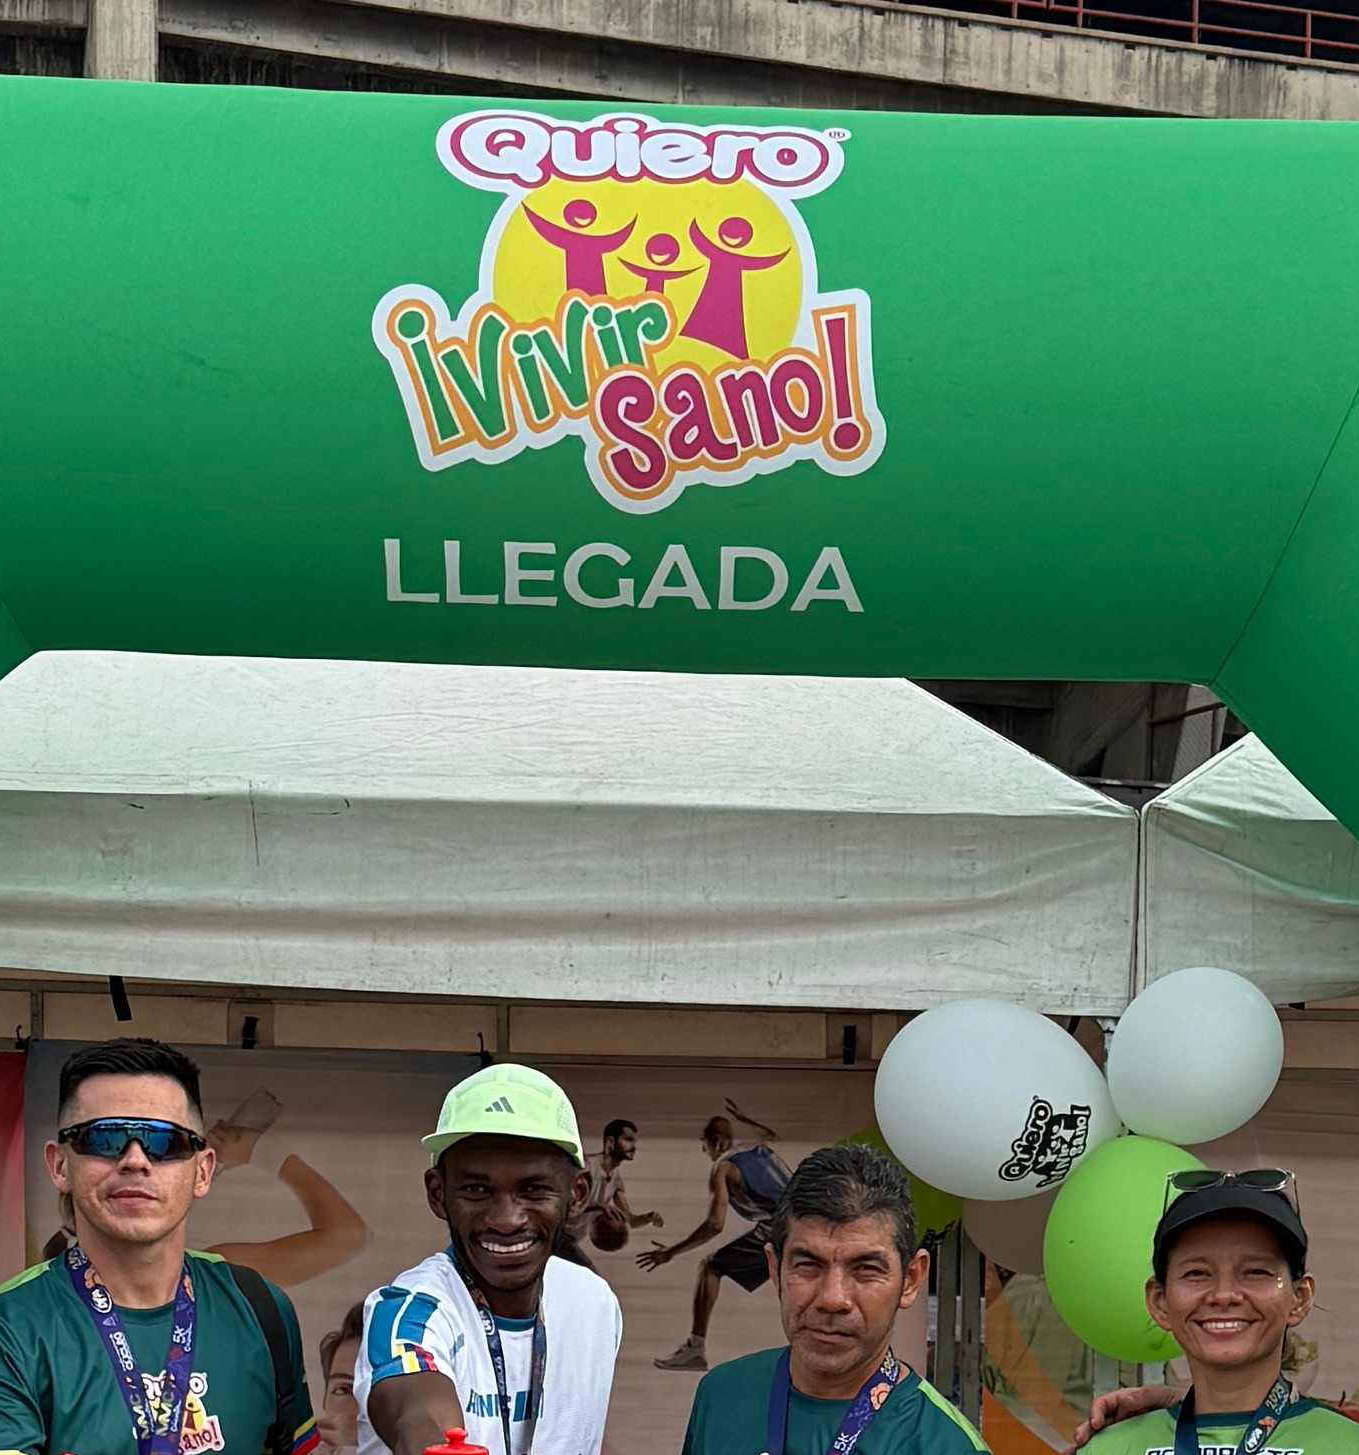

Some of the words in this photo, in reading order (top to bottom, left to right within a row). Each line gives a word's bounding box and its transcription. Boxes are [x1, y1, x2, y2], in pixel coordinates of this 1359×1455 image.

[451, 116, 829, 186] Quiero
[383, 537, 865, 614] LLEGADA
[999, 1098, 1053, 1181] Quiero
